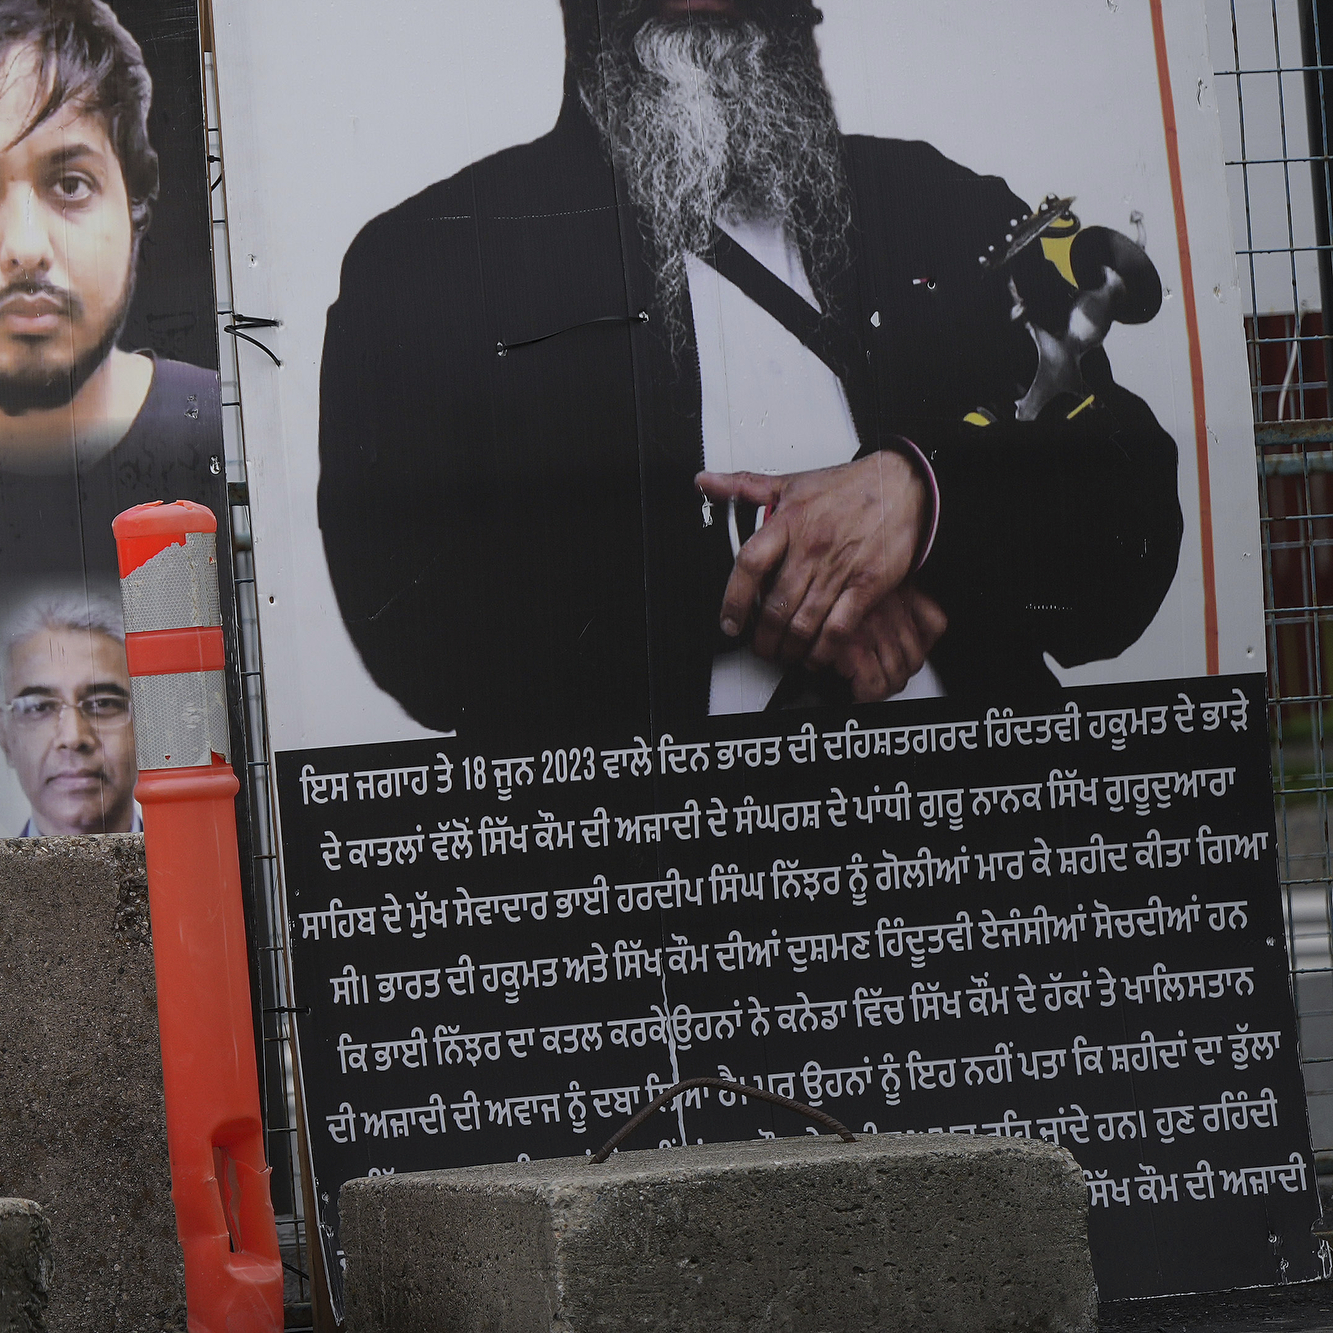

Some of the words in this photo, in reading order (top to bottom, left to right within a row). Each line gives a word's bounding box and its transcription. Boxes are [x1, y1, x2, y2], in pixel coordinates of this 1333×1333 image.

[298, 764, 350, 804] ਇਸ
[353, 765, 430, 801] ਜਗਾਹ
[433, 752, 454, 793] ਤੇ
[461, 755, 487, 790] 18
[491, 756, 535, 801] ਜੂਨ
[541, 746, 595, 784] 2023
[600, 735, 652, 779] ਵਾਲੇ
[656, 733, 711, 775] ਦਿਨ
[714, 736, 783, 770] ਭਾਰਤ
[786, 722, 817, 764] ਦੀ
[821, 718, 978, 761] ਦਹਿਸ਼ਤਗਰਦ
[1086, 705, 1169, 751] ਹਕੂਮਤ
[1172, 693, 1196, 732] ਦੇ
[1199, 688, 1250, 732] ਭਾੜੇ
[320, 830, 342, 871] ਦੇ
[345, 824, 425, 868] ਕਾਤਲਾਂ
[428, 816, 473, 861] ਵੱਲੋਂ
[477, 815, 528, 856] ਸਿੱਖ
[532, 809, 575, 851] ਕੌਮ
[579, 806, 610, 848] ਦੀ
[614, 799, 701, 843] ਅਜ਼ਾਦੀ
[705, 797, 728, 837] ਦੇ
[732, 795, 821, 835] ਸੰਘਰਸ਼
[825, 787, 848, 827] ਦੇ
[852, 780, 911, 824] ਪਾਂਧੀ
[916, 788, 964, 831] ਗੁਰੂ
[969, 783, 1042, 816] ਨਾਨਕ
[1046, 768, 1098, 809] ਸਿੱਖ
[1102, 767, 1236, 816] ਗੁਰੂਦੁਆਰਾ
[298, 897, 377, 940] ਸਾਹਿਬ
[380, 893, 402, 934] ਦੇ
[405, 891, 448, 939] ਮੁੱਖ
[452, 886, 549, 926] ਸੇਵਾਦਾਰ
[553, 874, 609, 919] ਭਾਈ
[614, 867, 703, 912] ਹਰਦੀਪ
[708, 863, 765, 904] ਸਿੰਘ
[769, 859, 841, 902] ਨਿੱਝਰ
[845, 853, 868, 906] ਨੂੰ
[873, 846, 970, 891] ਗੋਲੀਆਂ
[974, 850, 1024, 882] ਮਾਰ
[1028, 837, 1052, 877] ਕੇ
[1056, 833, 1128, 875] ਸ਼ਹੀਦ
[1132, 828, 1191, 869] ਕੀਤਾ
[1195, 825, 1269, 865] ਗਿਆ
[374, 968, 441, 1003] ਭਾਰਤ
[444, 954, 476, 996] ਦੀ
[479, 957, 559, 1004] ਹਕੂਮਤ
[562, 942, 609, 984] ਅਤੇ
[612, 938, 663, 980] ਸਿੱਖ
[665, 934, 709, 975] ਕੌਮ
[713, 928, 781, 972] ਦੀਆਂ
[785, 930, 871, 973] ਦੁਸ਼ਮਣ
[874, 910, 973, 969] ਹਿੰਦੂਤਵੀ
[977, 903, 1087, 950] ਏਜੰਸੀਆਂ
[1090, 895, 1201, 939] ਸੋਚਦੀਆਂ
[1205, 900, 1248, 931] ਹਨ
[336, 1033, 368, 1074] ਕਿ
[371, 1026, 428, 1072] ਭਾਈ
[432, 1024, 501, 1068] ਨਿੱਝਰ
[505, 1027, 535, 1058] ਦਾ
[539, 1022, 602, 1054] ਕਤਲ
[606, 1004, 669, 1048] ਕਰਕੇ
[671, 999, 743, 1052] ਉਹਨਾਂ
[747, 996, 769, 1037] ਨੇ
[774, 991, 847, 1033] ਕਨੇਡਾ
[852, 987, 904, 1028] ਵਿੱਚ
[908, 982, 961, 1022] ਸਿੱਖ
[1013, 973, 1037, 1014] ਦੇ
[1040, 970, 1091, 1012] ਹੱਕਾਂ
[1096, 966, 1116, 1007] ਤੇ
[1120, 962, 1254, 1003] ਖਾਲਿਸਤਾਨ
[325, 1102, 357, 1144] ਦੀ
[359, 1093, 447, 1139] ਅਜ਼ਾਦੀ
[450, 1090, 481, 1131] ਦੀ
[484, 1093, 561, 1127] ਅਵਾਜ
[563, 1080, 586, 1133] ਨੂੰ
[590, 1086, 640, 1118] ਦਬਾ
[799, 1055, 873, 1107] ਉਹਨਾਂ
[877, 1052, 901, 1106] ਨੂੰ
[905, 1050, 957, 1090] ਇਹ
[960, 1041, 1013, 1086] ਨਹੀਂ
[1016, 1048, 1067, 1080] ਪਤਾ
[1071, 1035, 1104, 1075] ਕਿ
[1106, 1029, 1188, 1073] ਸ਼ਹੀਦਾਂ
[1192, 1035, 1223, 1066] ਦਾ
[1227, 1022, 1282, 1071] ਡੁੱਲਾ
[1036, 1104, 1090, 1145] ਜਾਂਦੇ
[1152, 1105, 1196, 1144] ਹੁਣ
[1198, 1087, 1278, 1132] ਰਹਿੰਦੀ
[1134, 1163, 1179, 1204] ਕੌਮ
[1184, 1159, 1215, 1200] ਦੀ
[1219, 1151, 1307, 1196] ਅਜ਼ਾਦੀ
